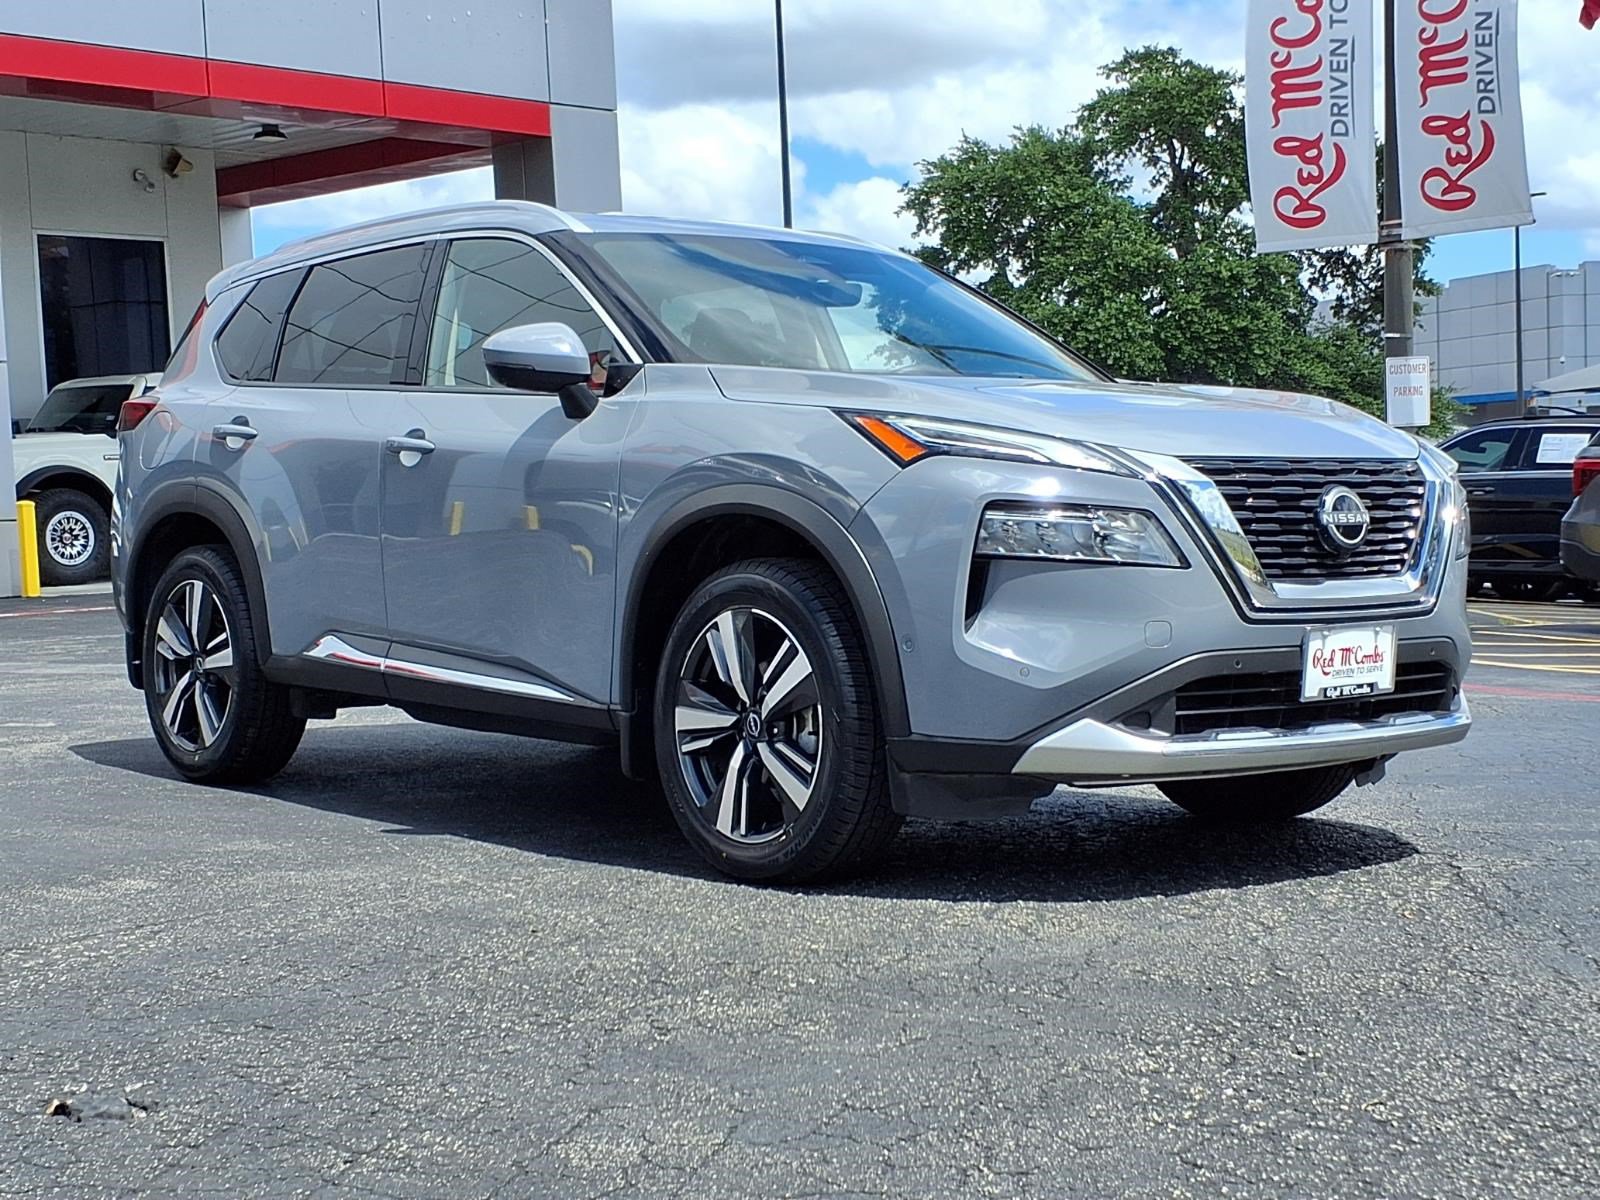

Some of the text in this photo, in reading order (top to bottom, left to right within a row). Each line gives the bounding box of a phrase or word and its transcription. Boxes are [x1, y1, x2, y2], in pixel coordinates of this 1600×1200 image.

[1474, 11, 1497, 115] DRIVEN
[1329, 38, 1350, 138] DRIVEN
[1420, 110, 1495, 212] Red
[1273, 132, 1347, 229] Red
[1389, 363, 1427, 375] CUSTOMER
[1393, 385, 1424, 397] PARKING
[1322, 512, 1369, 525] NISSAN
[1312, 644, 1384, 676] Red McCombs
[1332, 664, 1384, 678] DRIVEN TO SERVE
